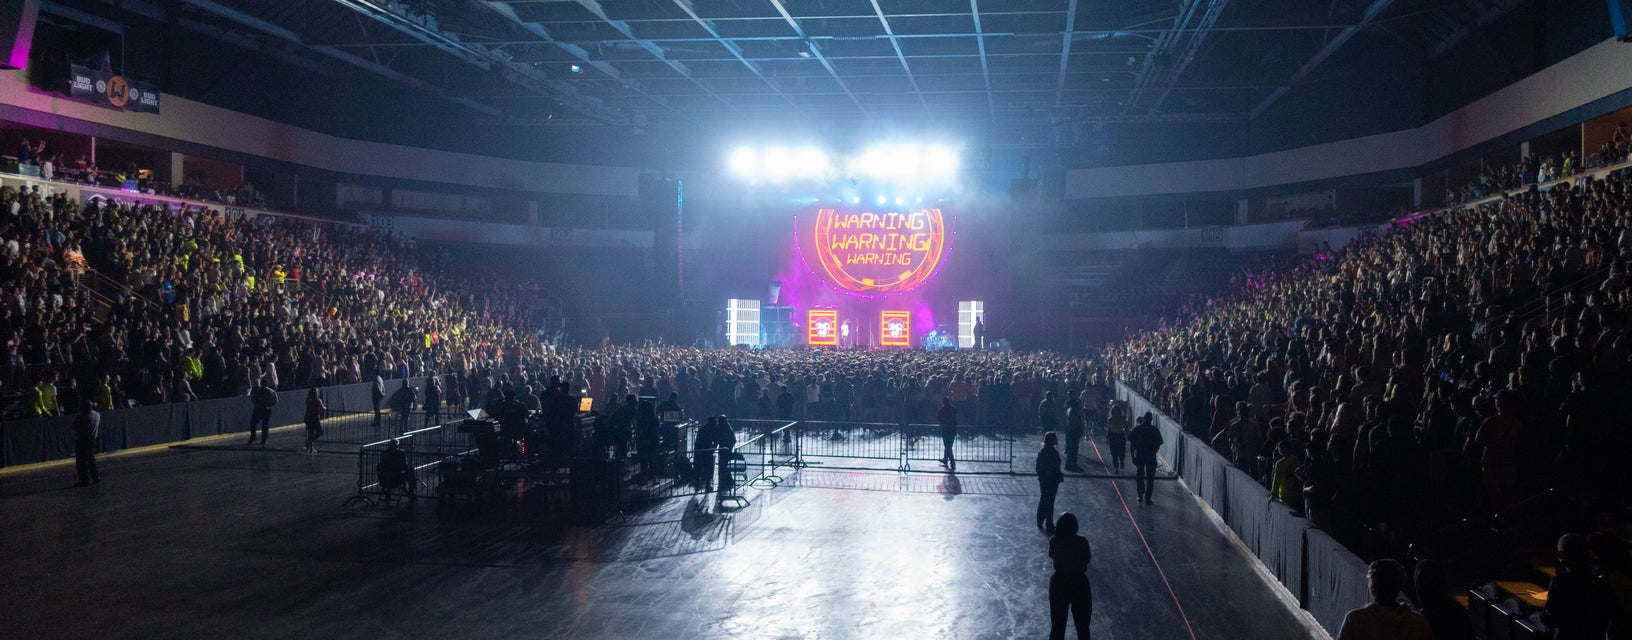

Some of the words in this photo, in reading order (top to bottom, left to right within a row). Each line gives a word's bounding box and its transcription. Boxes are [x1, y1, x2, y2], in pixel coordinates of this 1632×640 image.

[76, 75, 91, 85] BUD
[73, 81, 93, 92] LIGHT
[140, 96, 158, 106] LIGHT
[143, 91, 156, 100] BUD
[372, 215, 393, 228] 103
[834, 212, 925, 230] WARNING
[832, 233, 926, 251] WARNING
[847, 253, 911, 265] WARNING
